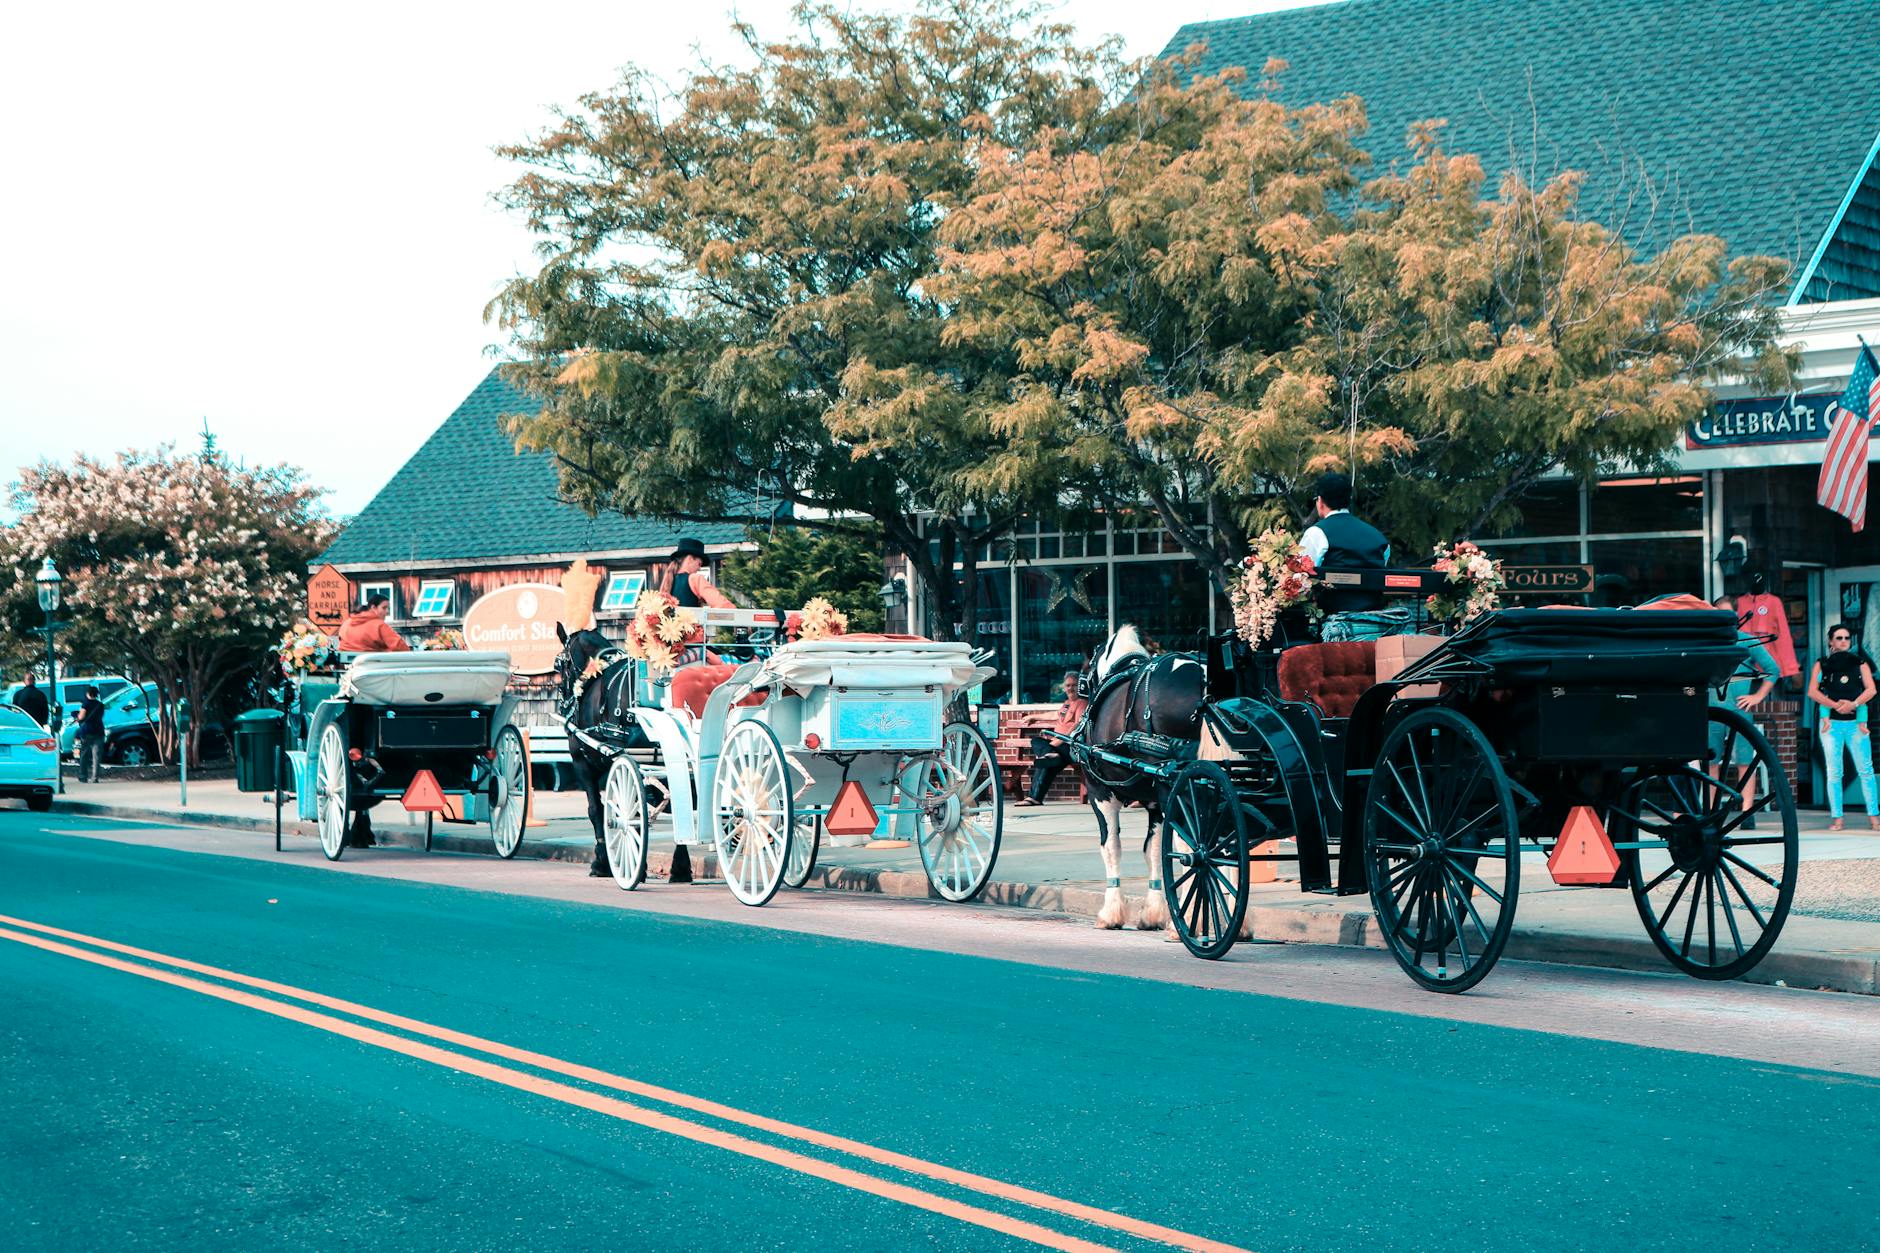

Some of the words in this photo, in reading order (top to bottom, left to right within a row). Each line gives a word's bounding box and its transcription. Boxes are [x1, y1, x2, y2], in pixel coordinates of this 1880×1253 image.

[1502, 569, 1578, 586] Tours
[315, 580, 340, 589] HORSE
[320, 591, 337, 599] AND
[309, 601, 348, 609] CARRIAGE
[471, 624, 527, 642] Comfort
